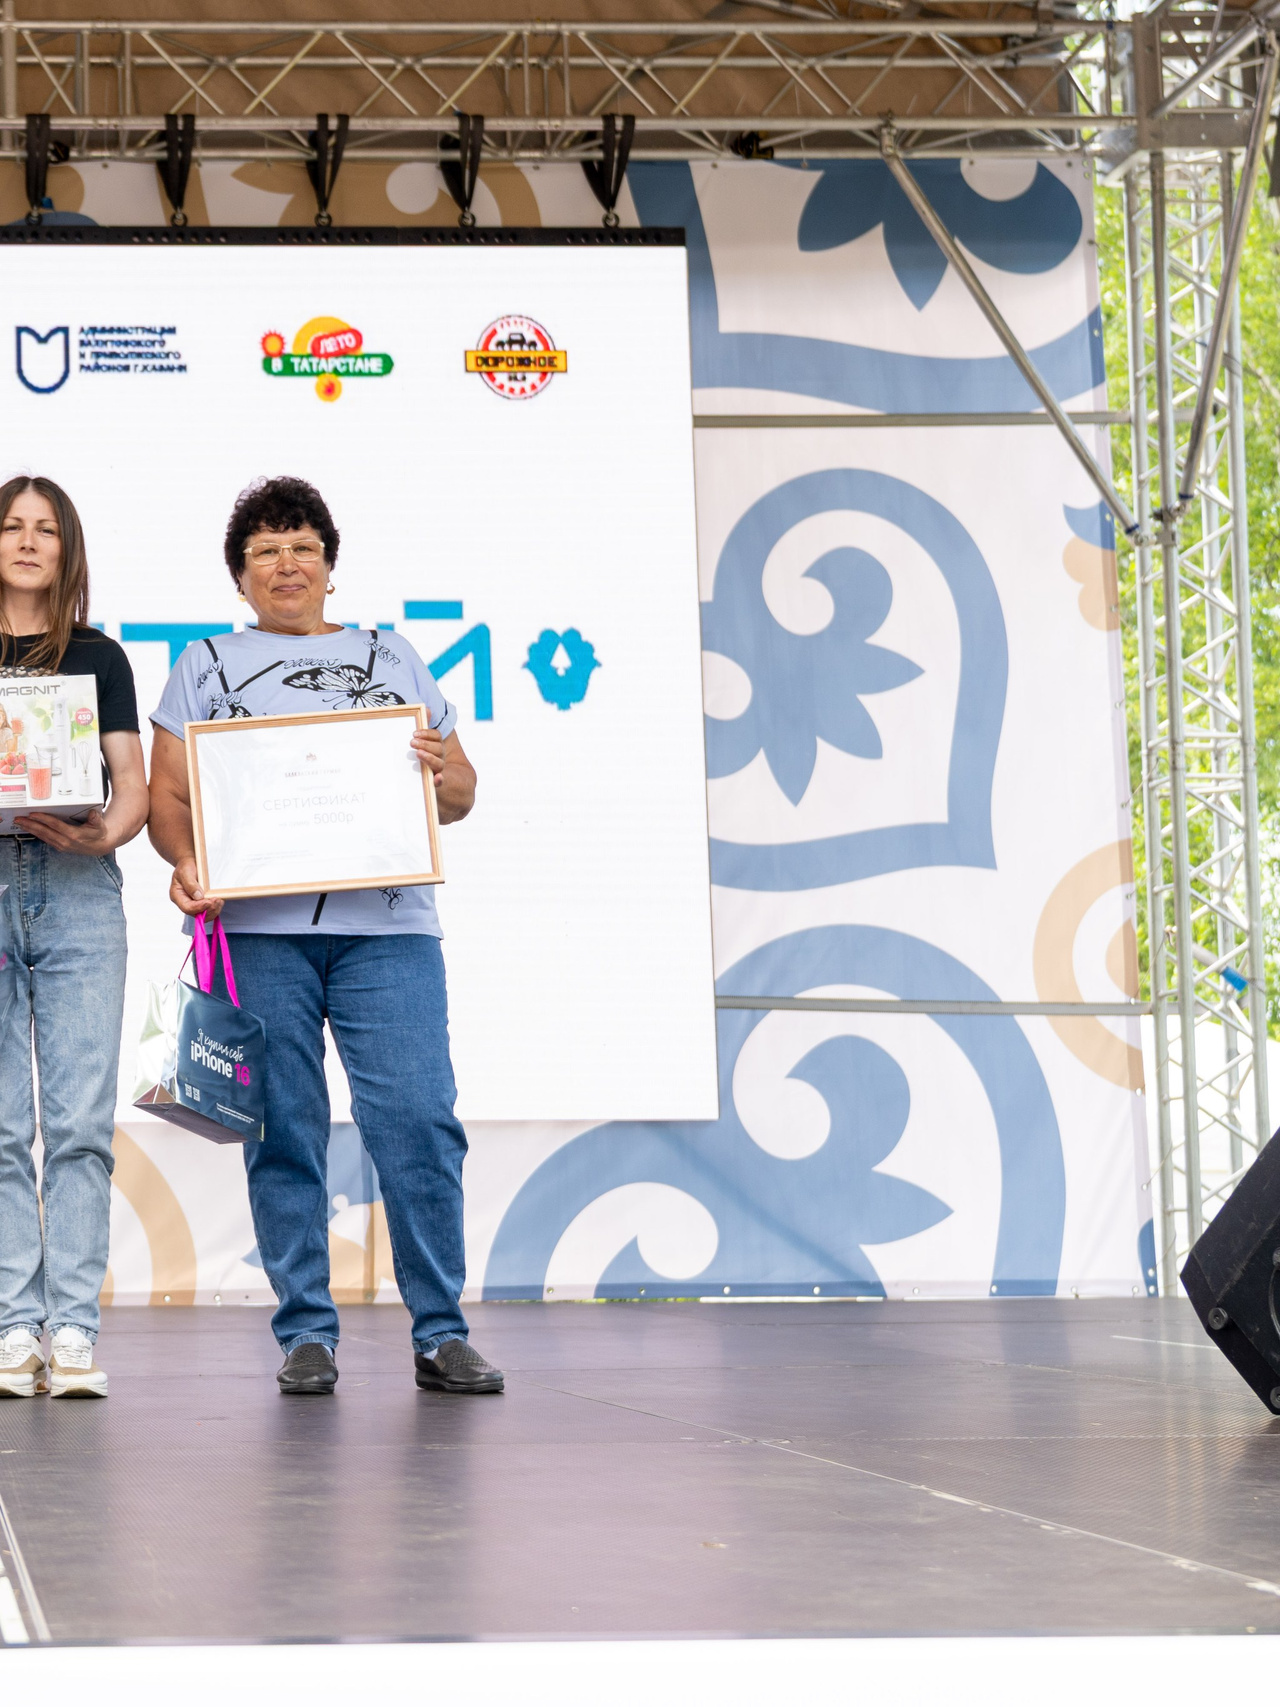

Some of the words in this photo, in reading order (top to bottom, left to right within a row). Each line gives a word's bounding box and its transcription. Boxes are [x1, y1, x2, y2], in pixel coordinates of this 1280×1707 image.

[320, 332, 356, 354] ЛЕТО
[271, 357, 283, 373] В
[290, 357, 383, 373] ТАТАРСТАНЕ
[262, 792, 366, 811] СЕРТИФИКАТ
[191, 1040, 233, 1078] iPhone
[234, 1063, 250, 1087] 16
